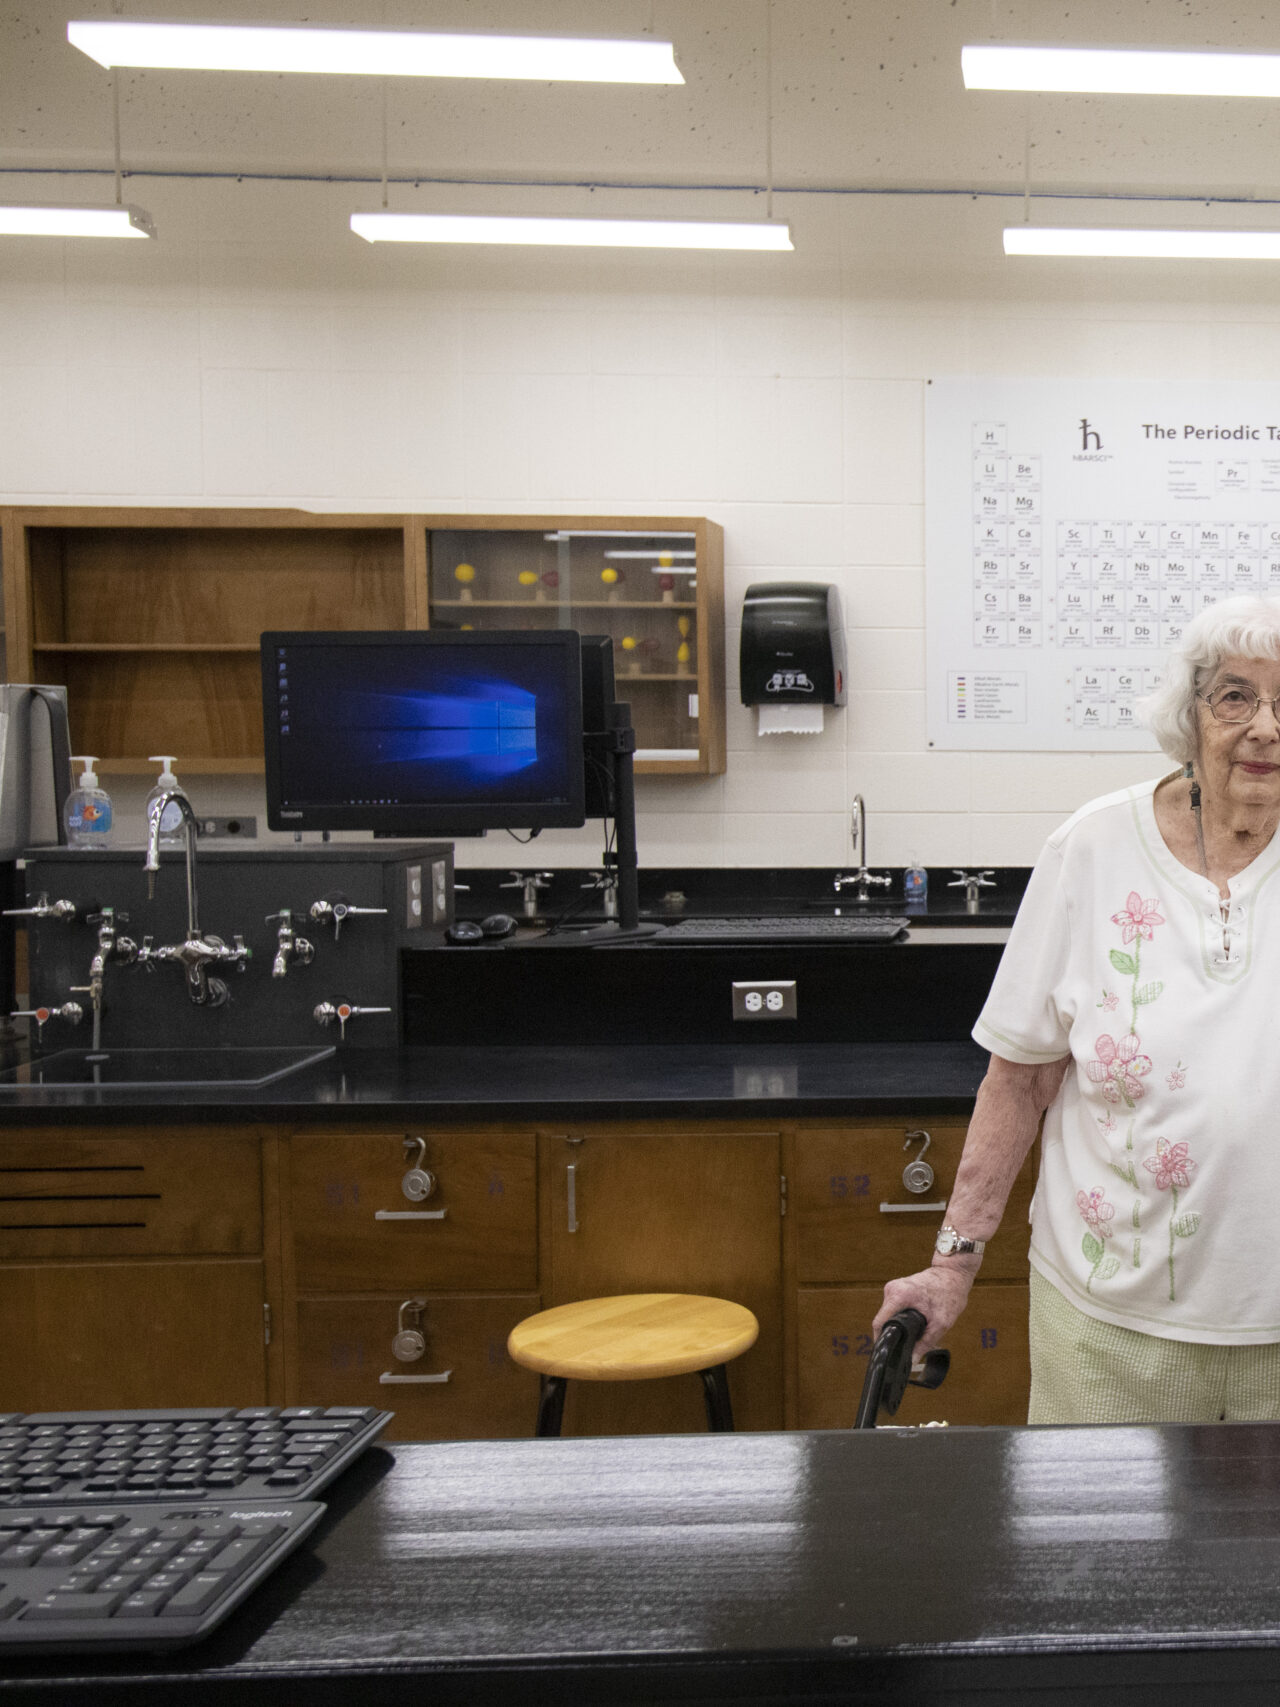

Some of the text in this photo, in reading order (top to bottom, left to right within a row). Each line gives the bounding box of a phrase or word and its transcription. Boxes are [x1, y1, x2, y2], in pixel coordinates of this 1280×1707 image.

[986, 432, 994, 440] H
[1142, 424, 1177, 440] The
[1184, 424, 1260, 441] Periodic
[985, 464, 994, 473] Li
[1018, 465, 1031, 473] Be
[983, 497, 997, 506] Na
[1016, 497, 1033, 509] Mg
[987, 529, 993, 537] K
[1018, 529, 1031, 538] Ca
[1068, 529, 1080, 538] Sc
[1104, 530, 1112, 538] Ti
[1139, 531, 1146, 539] V
[1170, 531, 1182, 540] Cr
[1202, 531, 1218, 539] Mn
[1238, 531, 1250, 540] Fe
[984, 561, 997, 570] Rb
[1020, 562, 1030, 570] Sr
[1071, 562, 1077, 571] Y
[1103, 562, 1113, 571] Zr
[1135, 563, 1149, 571] Nb
[1168, 563, 1184, 571] Mo
[1204, 563, 1215, 572] Tc
[1237, 563, 1250, 573] Ru
[985, 593, 997, 602] Cs
[1019, 594, 1031, 602] Ba
[1068, 594, 1080, 604] Lu
[1103, 594, 1114, 603] Hf
[1137, 595, 1148, 604] Ta
[1170, 595, 1181, 604] W
[986, 626, 996, 635] Fr
[1019, 626, 1031, 634] Ra
[1069, 627, 1079, 636] Lr
[1103, 626, 1114, 635] Rf
[1135, 627, 1150, 636] Db
[1086, 676, 1097, 685] La
[1119, 676, 1132, 685] Ce
[1085, 708, 1097, 717] Ac
[1120, 708, 1131, 717] Th
[831, 1176, 870, 1195] 52
[981, 1328, 998, 1349] B
[230, 1510, 293, 1520] logitech
